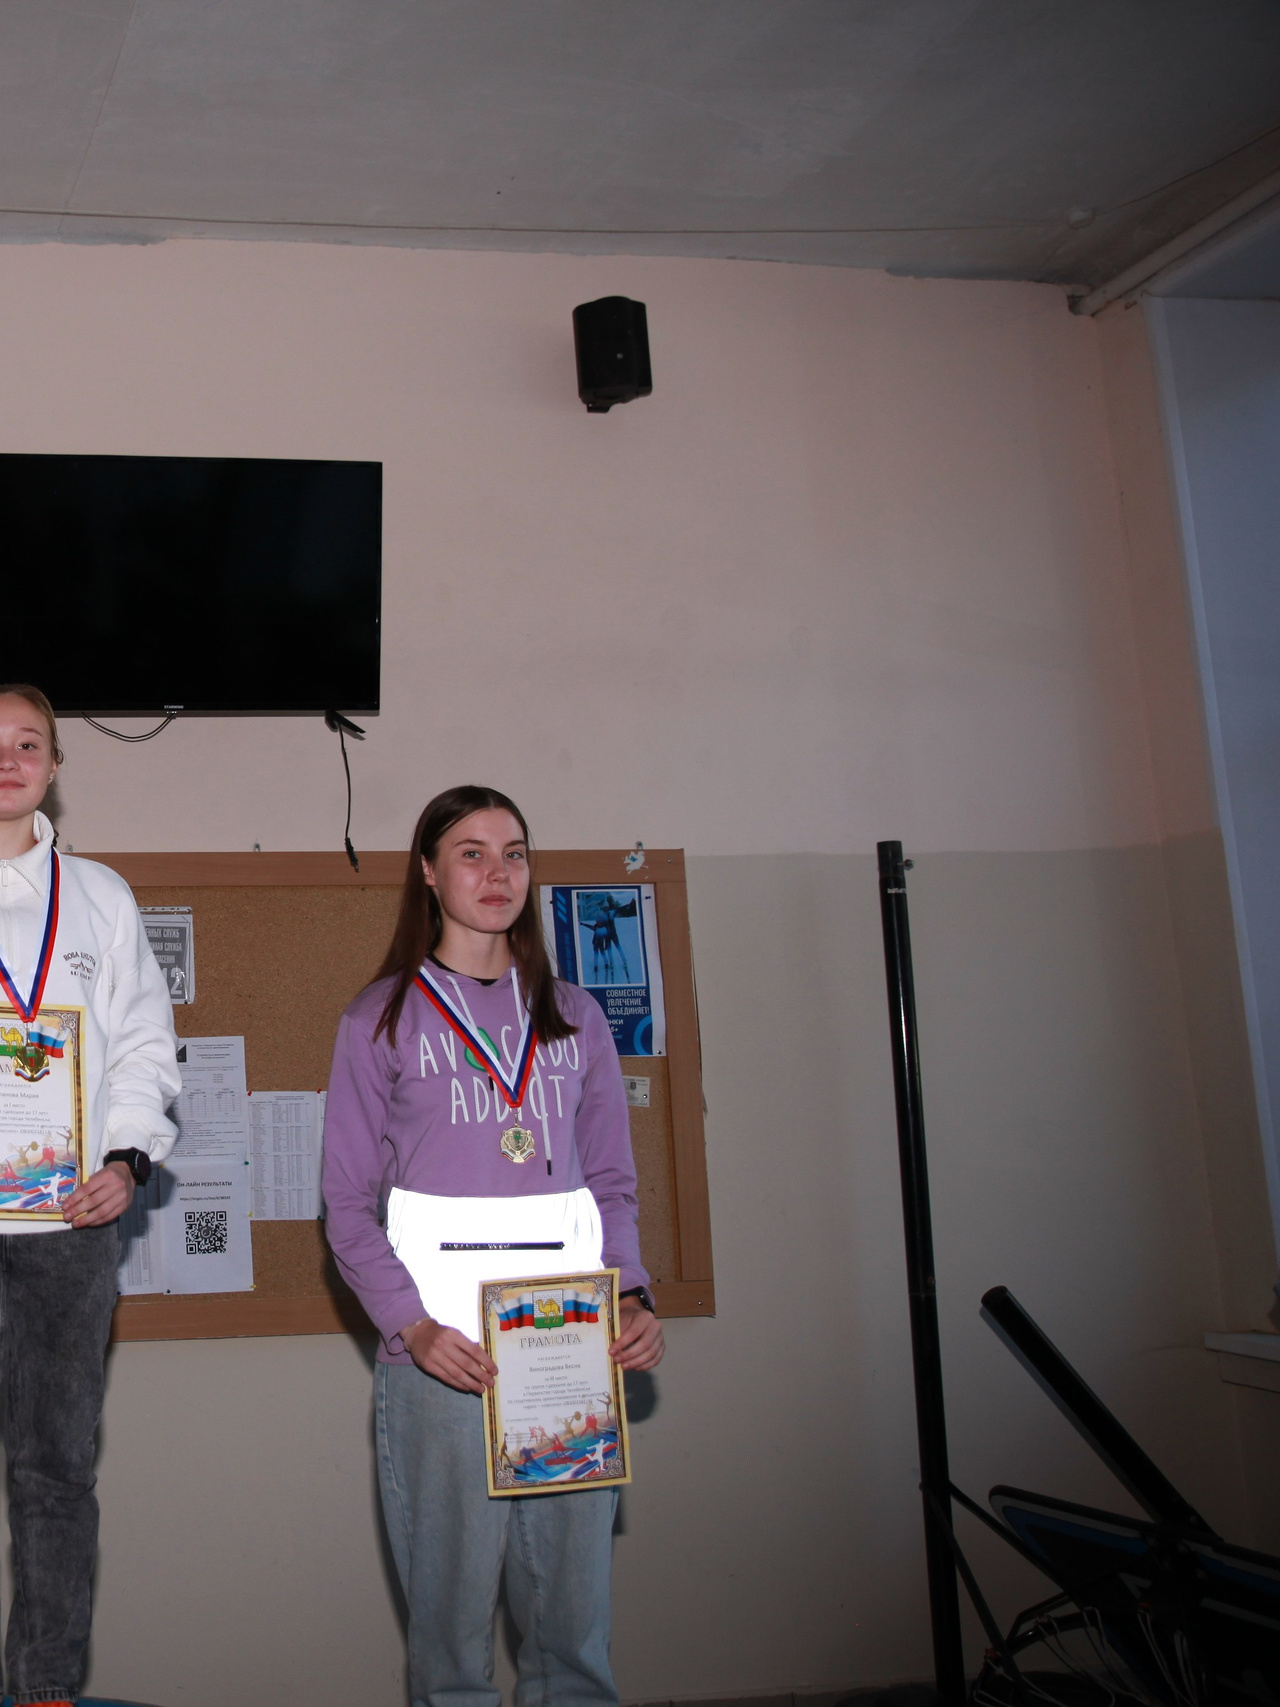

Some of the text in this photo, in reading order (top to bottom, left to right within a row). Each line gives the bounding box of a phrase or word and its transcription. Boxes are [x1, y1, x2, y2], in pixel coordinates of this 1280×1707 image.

[163, 928, 180, 938] СЛУЖБ
[165, 942, 182, 952] СЛУЖБА
[606, 989, 646, 997] СОВМЕСТНОЕ
[607, 998, 642, 1007] УВЛЕЧЕНИЕ
[608, 1007, 650, 1015] ОБЪЕДИНЯЕТ!
[421, 1026, 578, 1077] AVOCDO
[451, 1075, 564, 1124] ADDCT
[520, 1334, 581, 1348] ГРАМОТА
[529, 1365, 564, 1373] Виноградова
